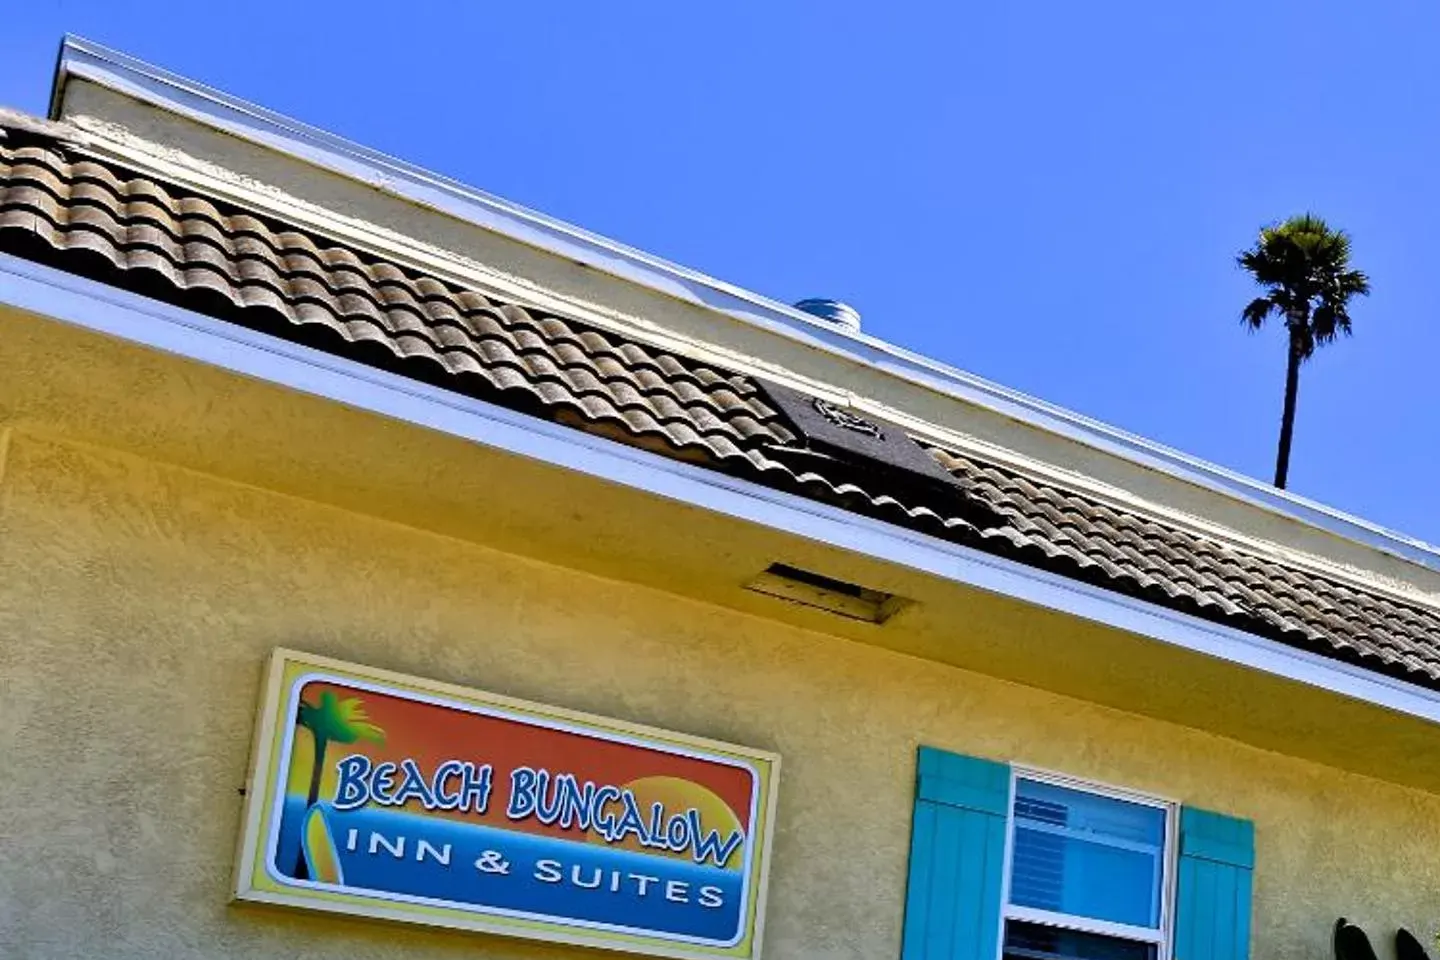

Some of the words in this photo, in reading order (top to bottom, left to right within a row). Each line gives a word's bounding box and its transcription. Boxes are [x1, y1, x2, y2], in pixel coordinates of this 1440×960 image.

[332, 754, 492, 812] BEACH
[507, 767, 743, 866] BUNGALOW
[347, 829, 452, 865] INN
[474, 850, 511, 875] &
[534, 859, 724, 907] SUITES
